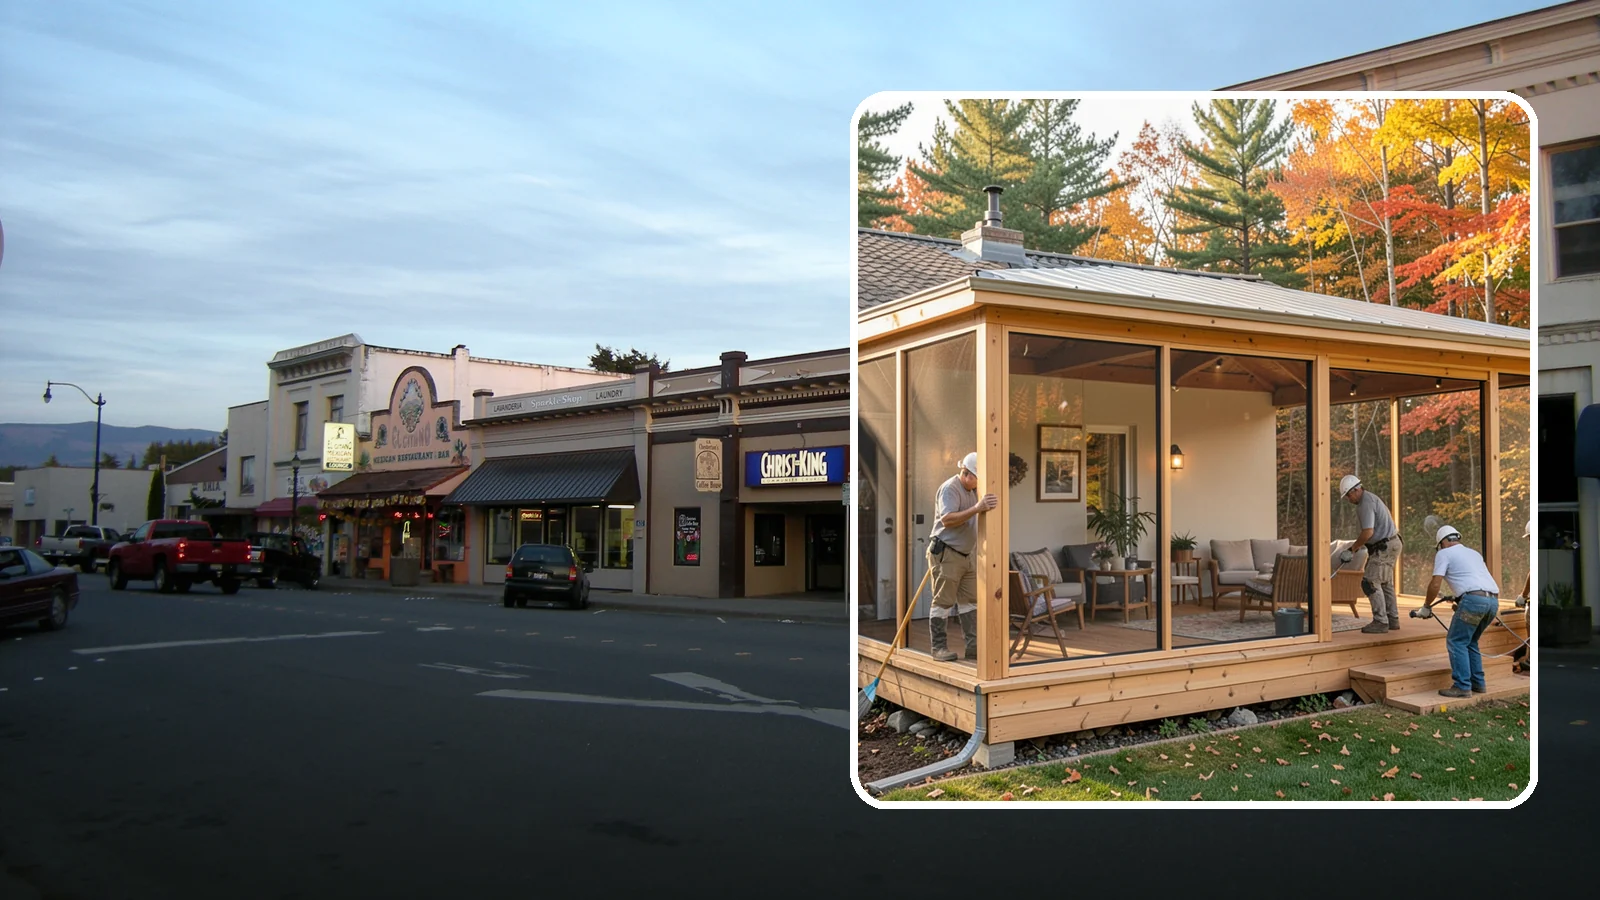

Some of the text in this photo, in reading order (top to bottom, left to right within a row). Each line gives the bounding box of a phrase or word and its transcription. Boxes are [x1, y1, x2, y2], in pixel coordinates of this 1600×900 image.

[531, 394, 582, 408] Sparkle Shop
[595, 389, 623, 400] LAUNDRY
[493, 402, 523, 412] LAVANDERIA
[374, 450, 450, 464] MEXICAN RESTAURANT BAR
[761, 450, 827, 478] CHRIST KING
